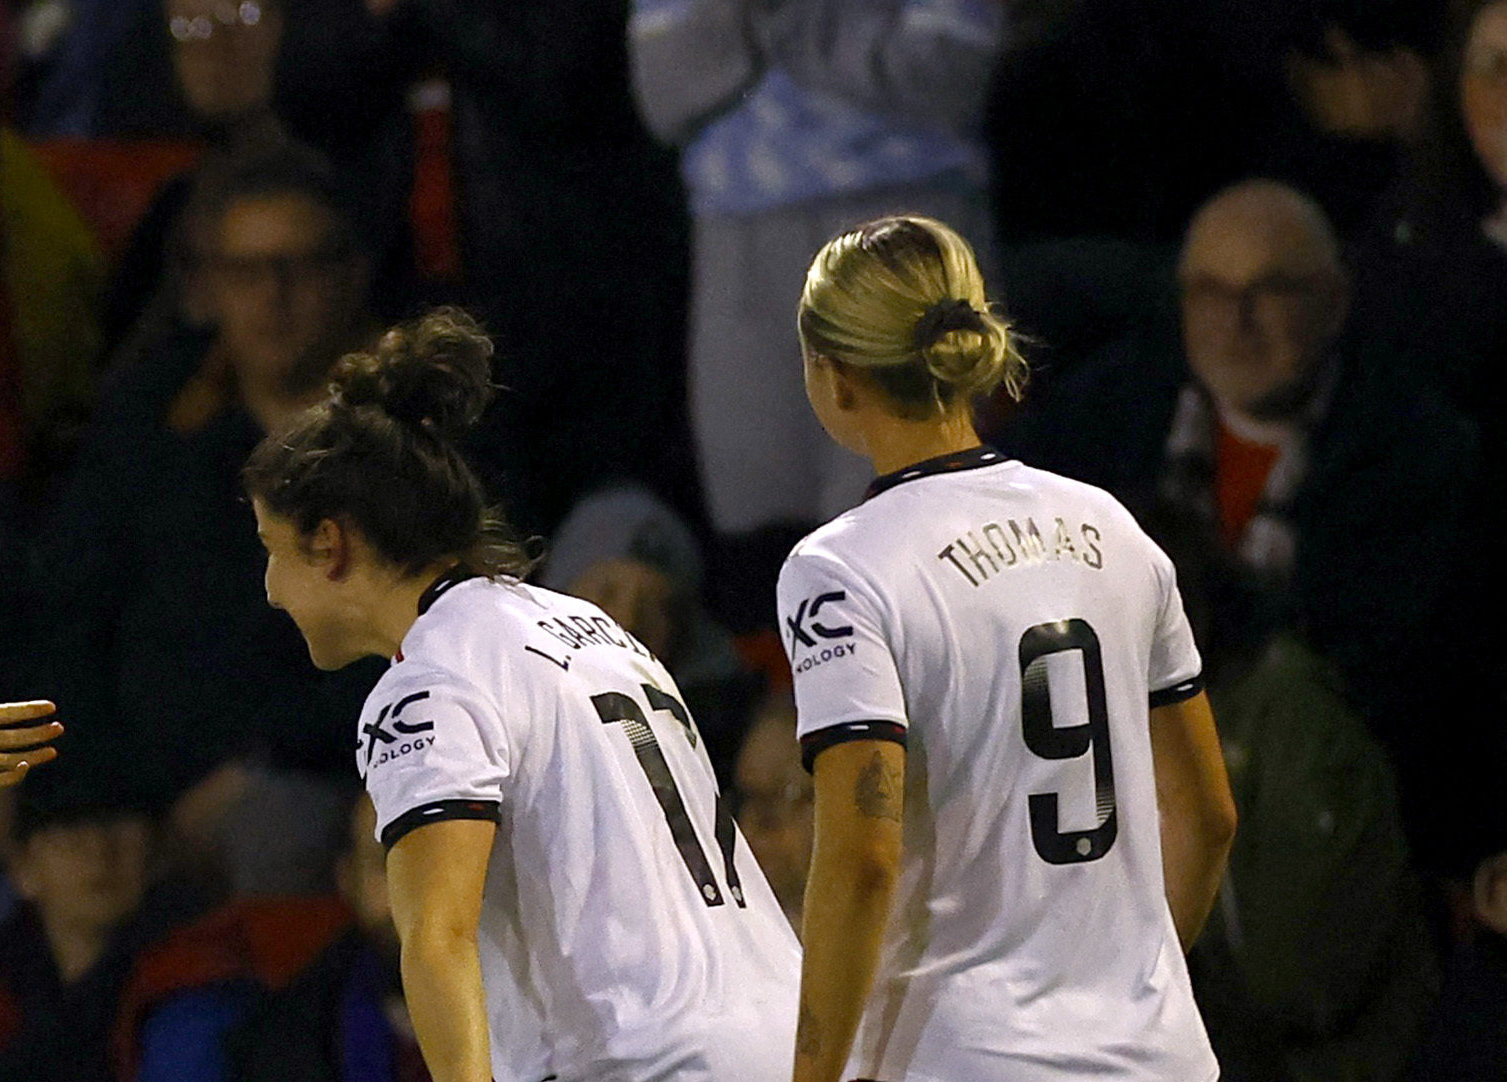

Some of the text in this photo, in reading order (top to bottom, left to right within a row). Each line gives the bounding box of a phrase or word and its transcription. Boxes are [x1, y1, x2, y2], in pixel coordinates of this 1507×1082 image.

[938, 518, 1102, 587] THOMAS
[524, 645, 572, 672] L.
[786, 591, 854, 661] XC
[373, 736, 435, 769] OLOGY
[1018, 618, 1118, 865] 9
